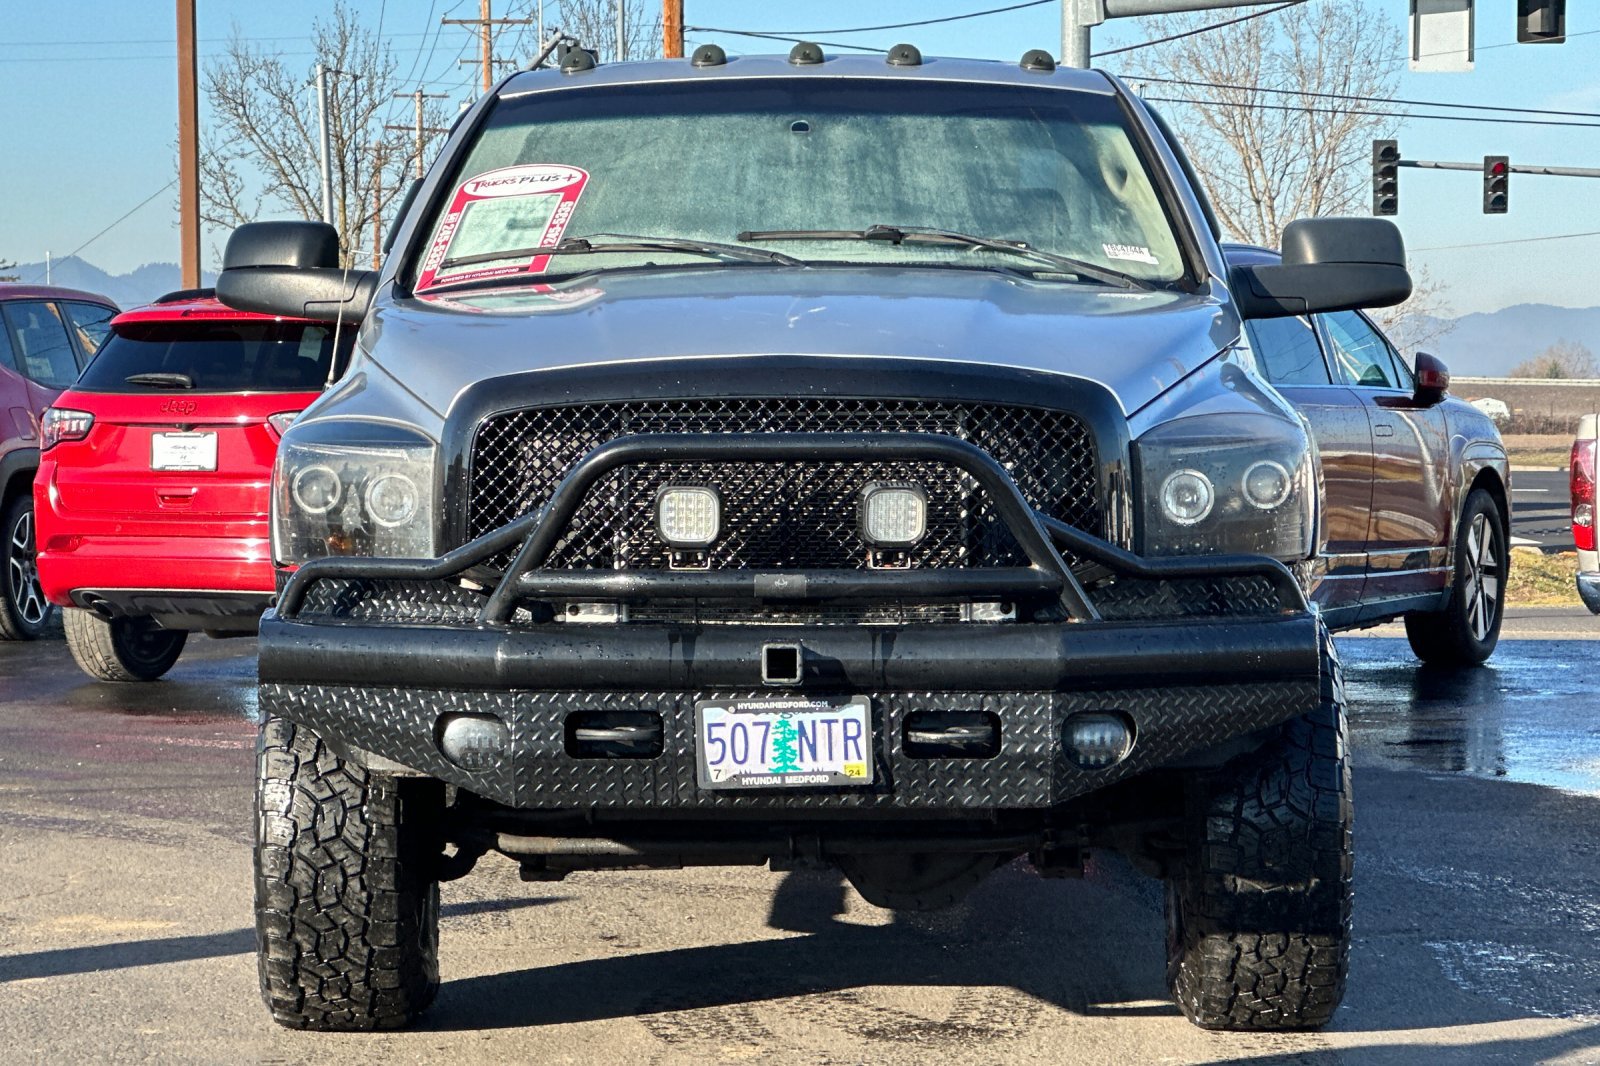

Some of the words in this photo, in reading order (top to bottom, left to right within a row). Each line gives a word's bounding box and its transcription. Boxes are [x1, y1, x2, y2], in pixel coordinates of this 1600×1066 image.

[470, 178, 517, 192] TRUCKS
[519, 174, 561, 185] PLUS
[160, 399, 198, 415] Jeep
[706, 721, 772, 766] 507
[798, 718, 863, 763] NTR
[713, 769, 722, 780] 7
[741, 776, 782, 786] HYUNDAI
[784, 774, 830, 785] MEDFORD
[848, 769, 861, 777] 24
